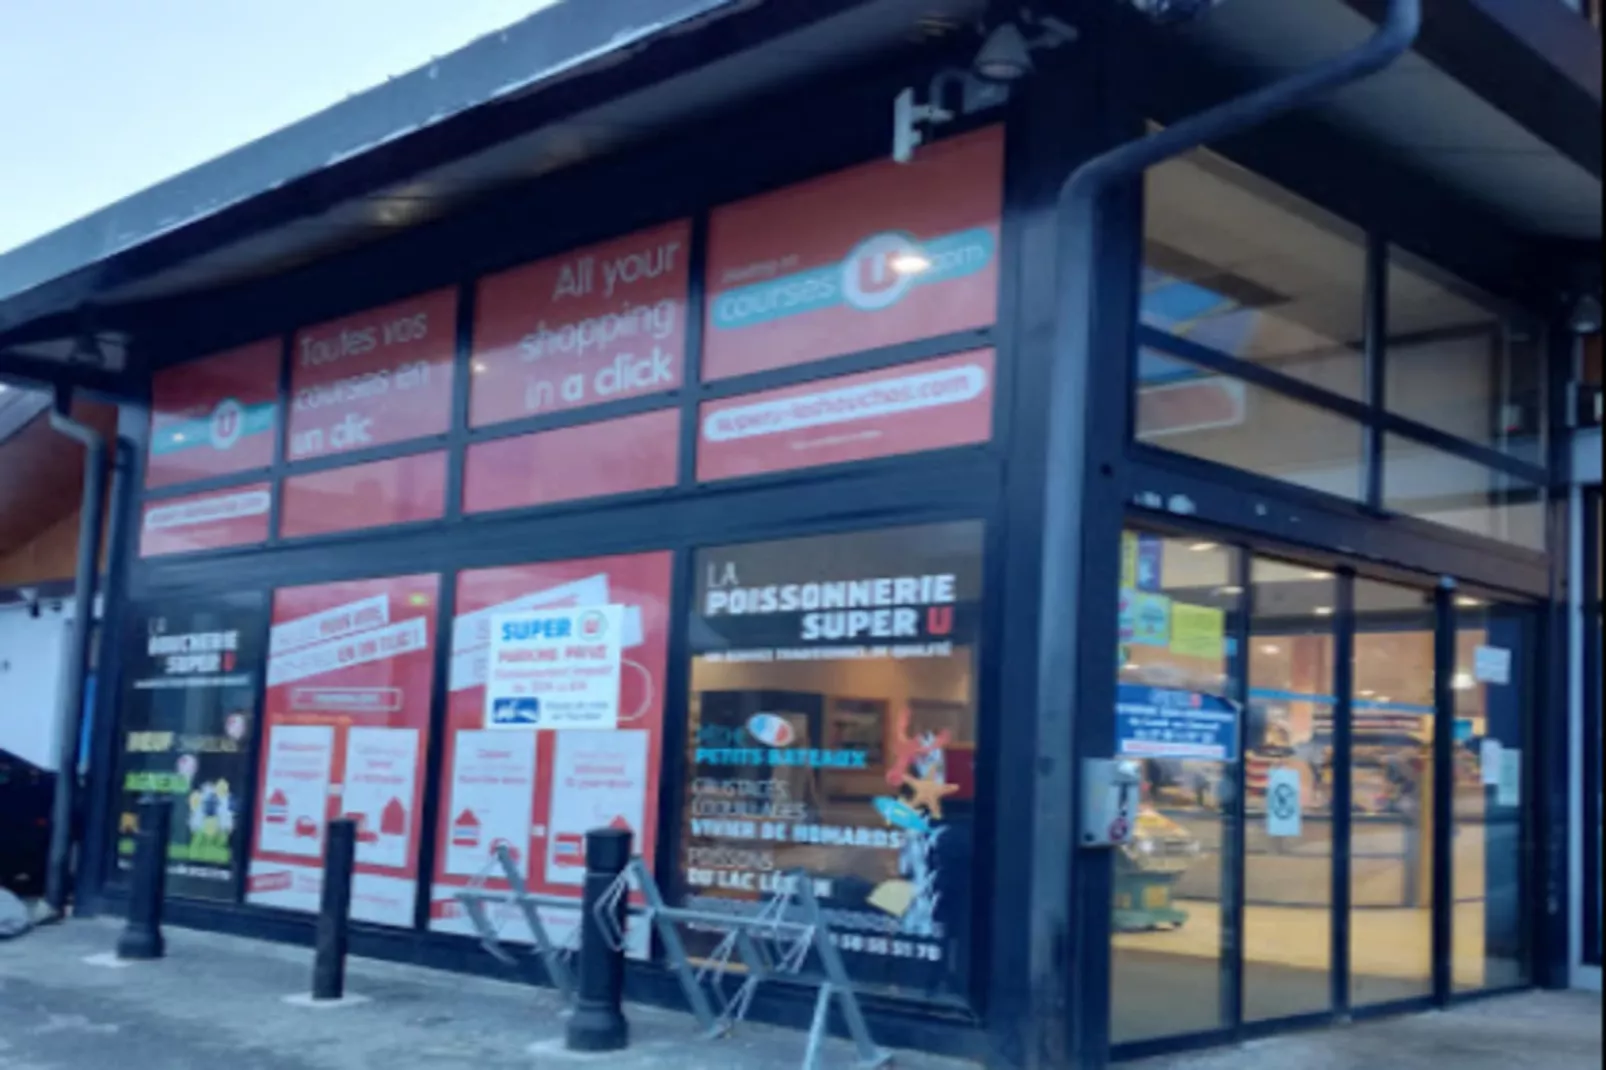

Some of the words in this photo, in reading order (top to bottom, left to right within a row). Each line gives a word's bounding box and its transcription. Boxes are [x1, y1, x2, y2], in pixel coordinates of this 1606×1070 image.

[552, 257, 595, 301] All
[603, 242, 681, 298] your
[299, 326, 376, 366] Toutes
[384, 313, 427, 345] vos
[519, 298, 676, 362] shopping
[296, 370, 389, 410] courses
[524, 374, 554, 410] in
[561, 373, 584, 402] a
[594, 346, 673, 395] click
[704, 573, 956, 616] POISSONNERIE
[706, 561, 739, 588] LA
[501, 617, 572, 641] SUPER
[802, 607, 918, 640] SUPER
[927, 606, 953, 635] U
[695, 748, 766, 767] PETITS
